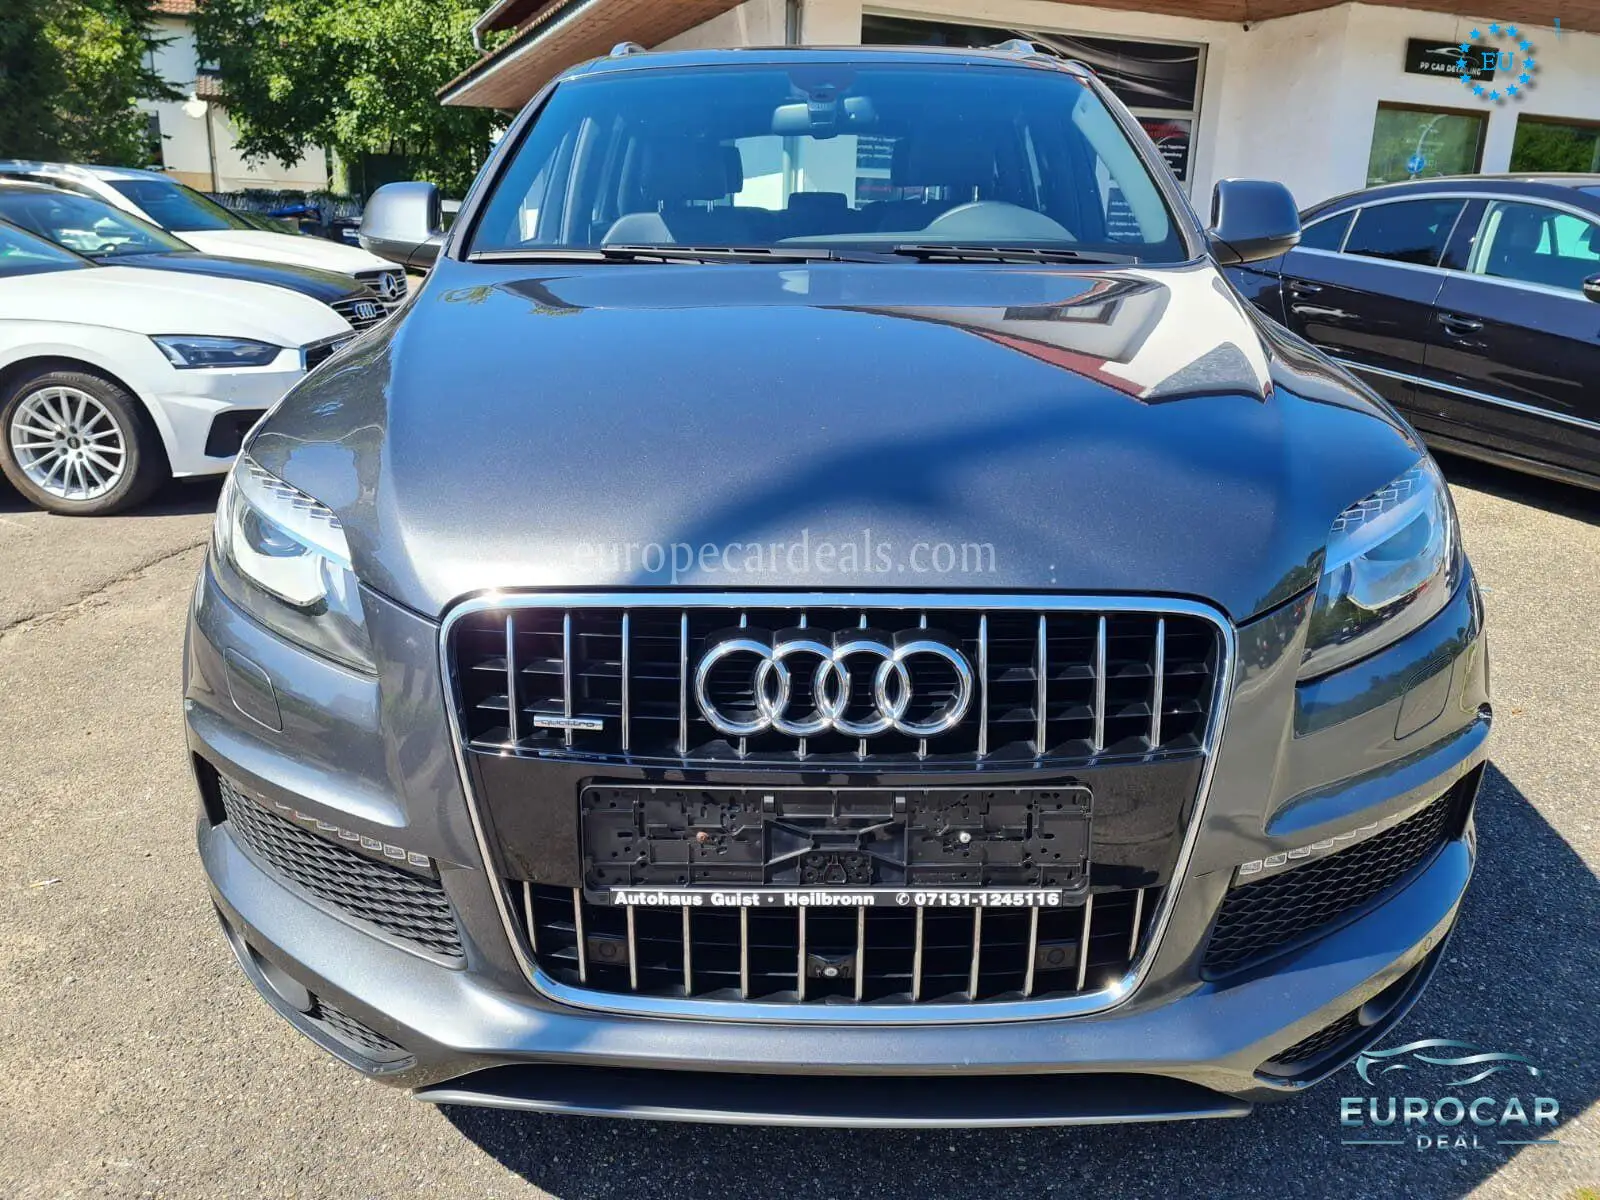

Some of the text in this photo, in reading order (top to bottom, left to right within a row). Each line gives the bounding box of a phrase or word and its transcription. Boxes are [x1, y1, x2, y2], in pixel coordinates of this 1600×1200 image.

[1420, 61, 1430, 70] PP
[1431, 63, 1446, 73] CAR
[614, 891, 1060, 906] Autohaus Guist Heilbronn 07131-1245116
